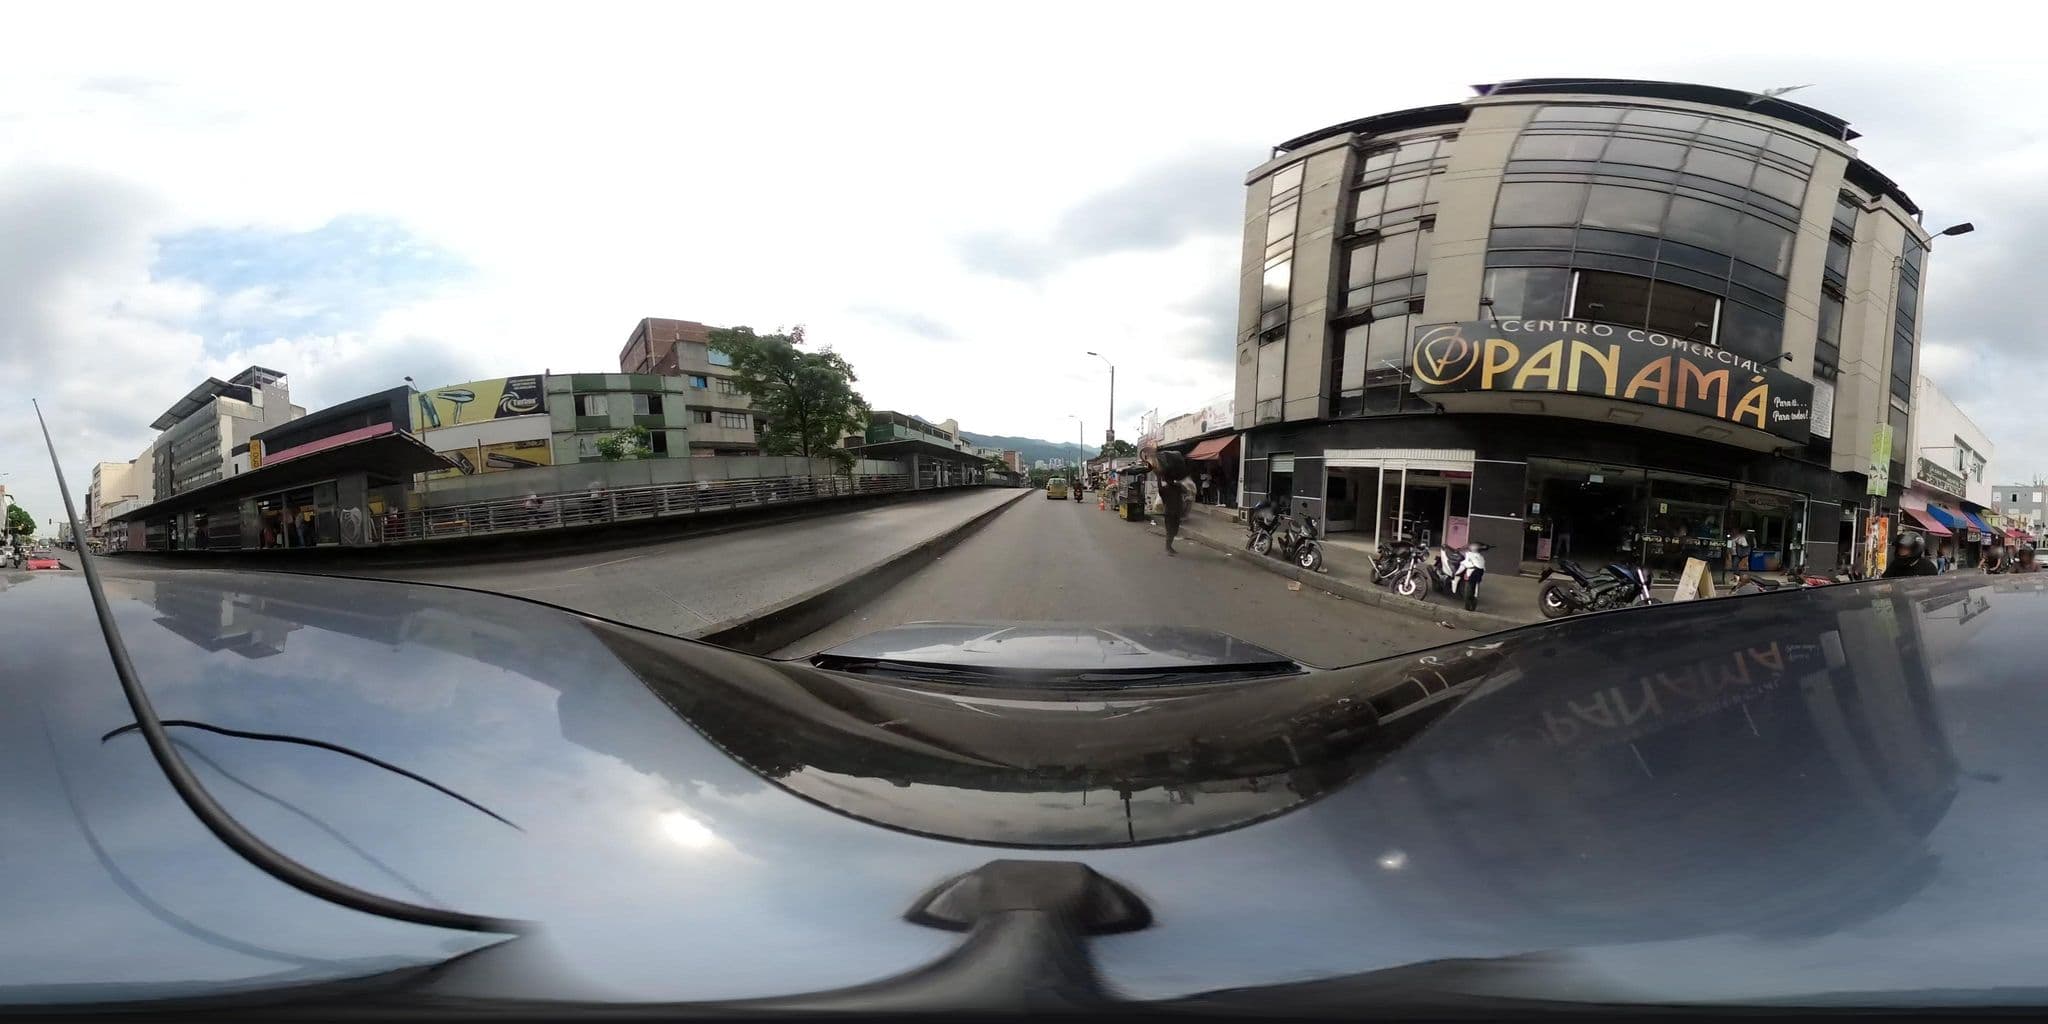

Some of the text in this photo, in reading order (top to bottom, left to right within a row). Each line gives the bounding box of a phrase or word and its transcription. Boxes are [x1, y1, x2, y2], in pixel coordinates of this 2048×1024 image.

[1502, 320, 1761, 374] CENTRO COMERCIAL
[1481, 338, 1769, 429] PANAMÁ
[1772, 410, 1790, 422] Para
[1773, 396, 1791, 408] Para
